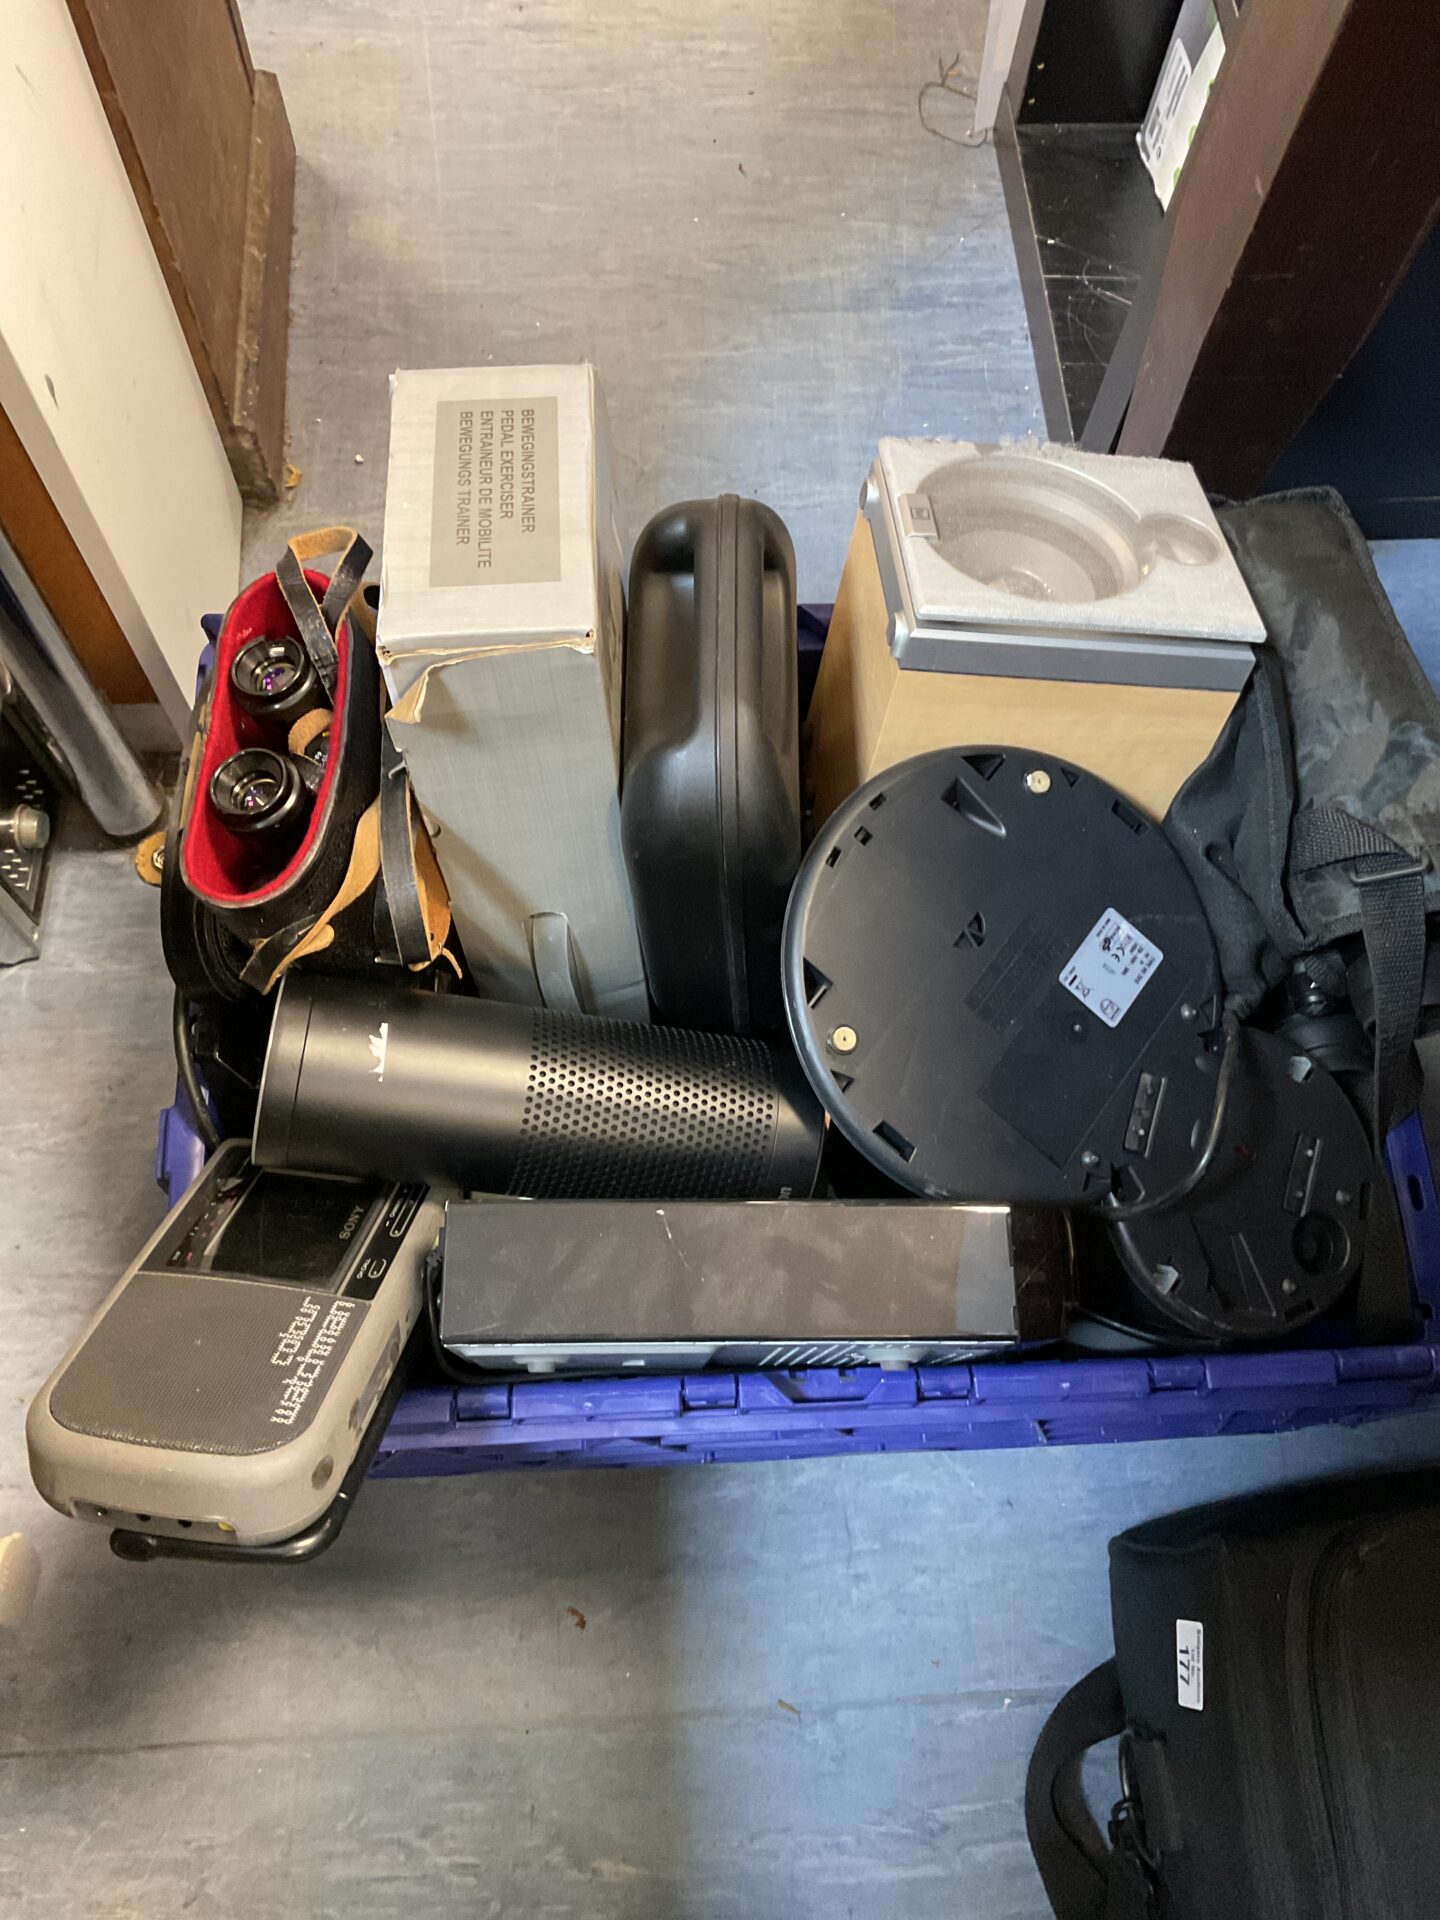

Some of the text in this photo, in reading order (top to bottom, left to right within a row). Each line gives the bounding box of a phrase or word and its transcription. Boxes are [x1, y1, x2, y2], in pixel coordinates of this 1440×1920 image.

[456, 411, 473, 545] BEWEGUNGS TRAINER
[477, 410, 494, 568] ENTRAINEUR DE MOBILITE
[500, 409, 514, 519] PEDAL EXERCISER
[521, 408, 535, 533] BEWEGINGSTRAINER
[338, 1205, 364, 1241] SONY
[270, 1296, 321, 1366] colour
[270, 1300, 355, 1425] watchman
[1179, 1645, 1190, 1686] 177
